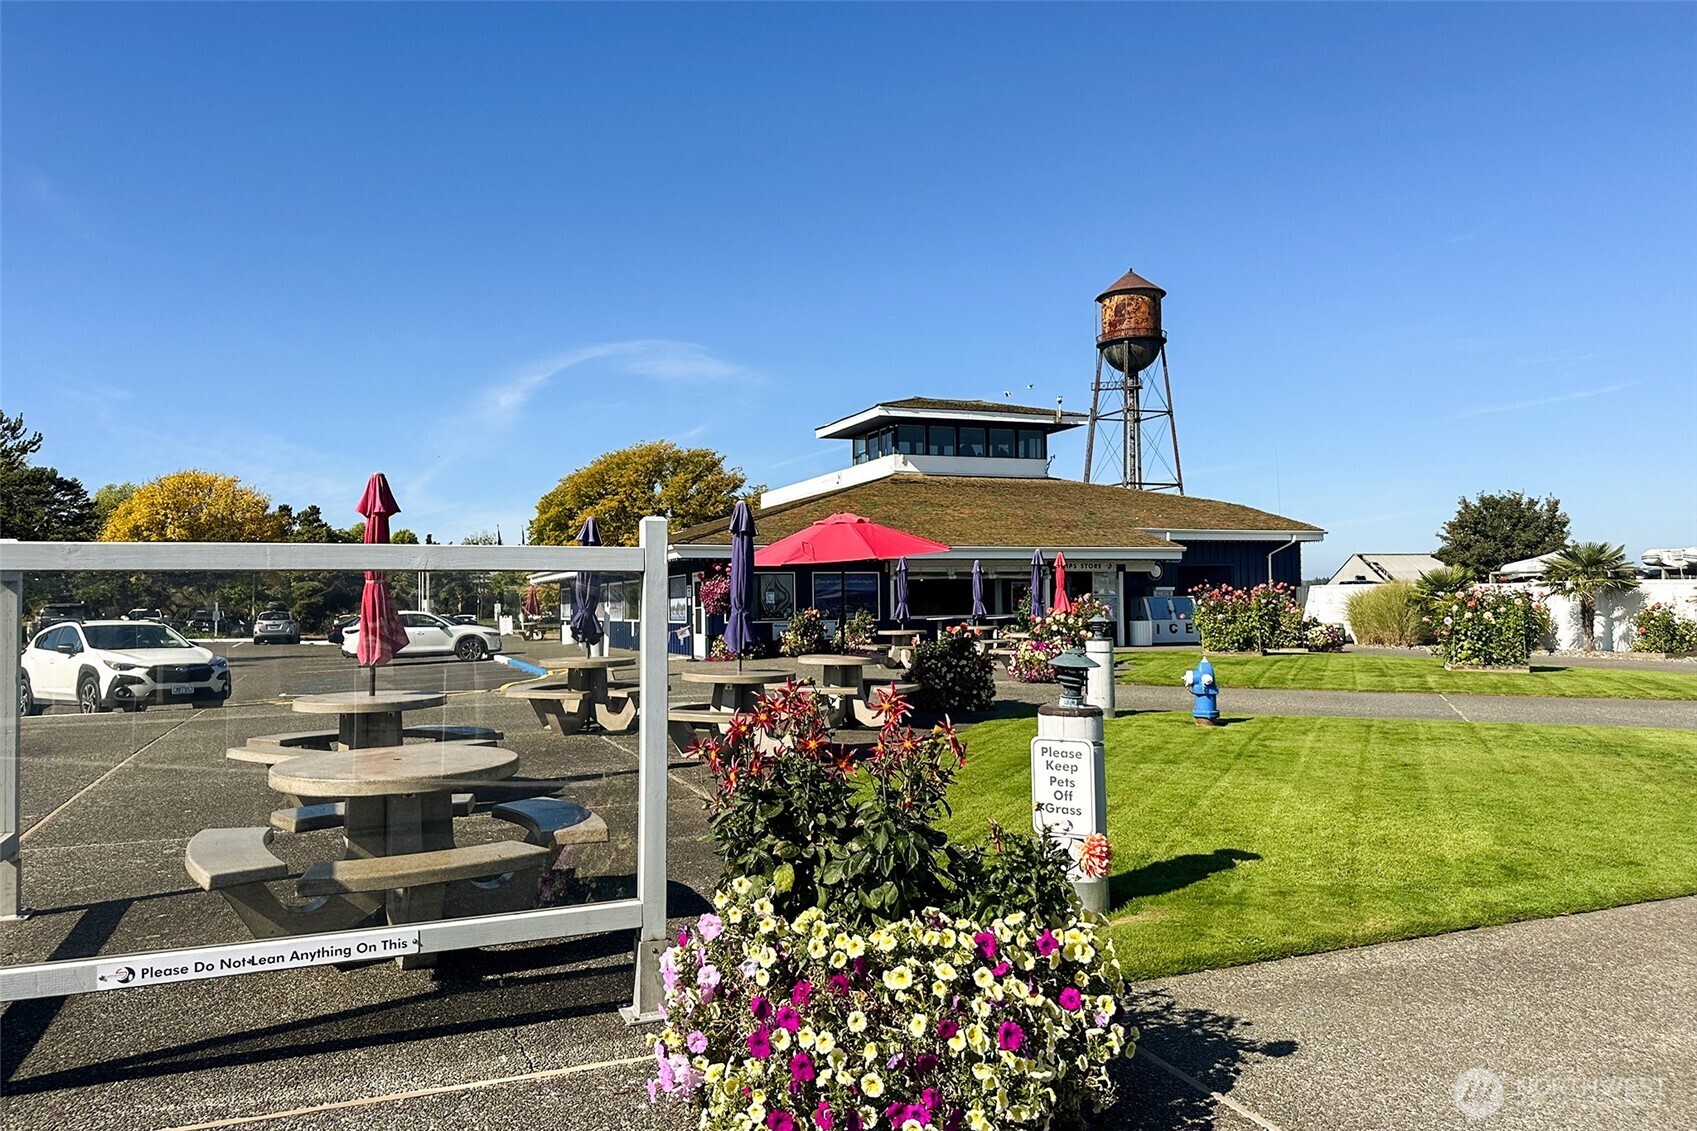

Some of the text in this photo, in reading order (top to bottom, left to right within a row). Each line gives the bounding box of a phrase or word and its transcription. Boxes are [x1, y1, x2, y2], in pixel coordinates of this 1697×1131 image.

[1156, 623, 1193, 634] ICE
[1041, 747, 1082, 759] Please
[1045, 760, 1078, 774] Keep
[1049, 776, 1075, 788] Pets
[1053, 790, 1073, 802] Off
[1045, 803, 1082, 816] Grass
[141, 938, 408, 979] Please Do Not Lean Anything On This
